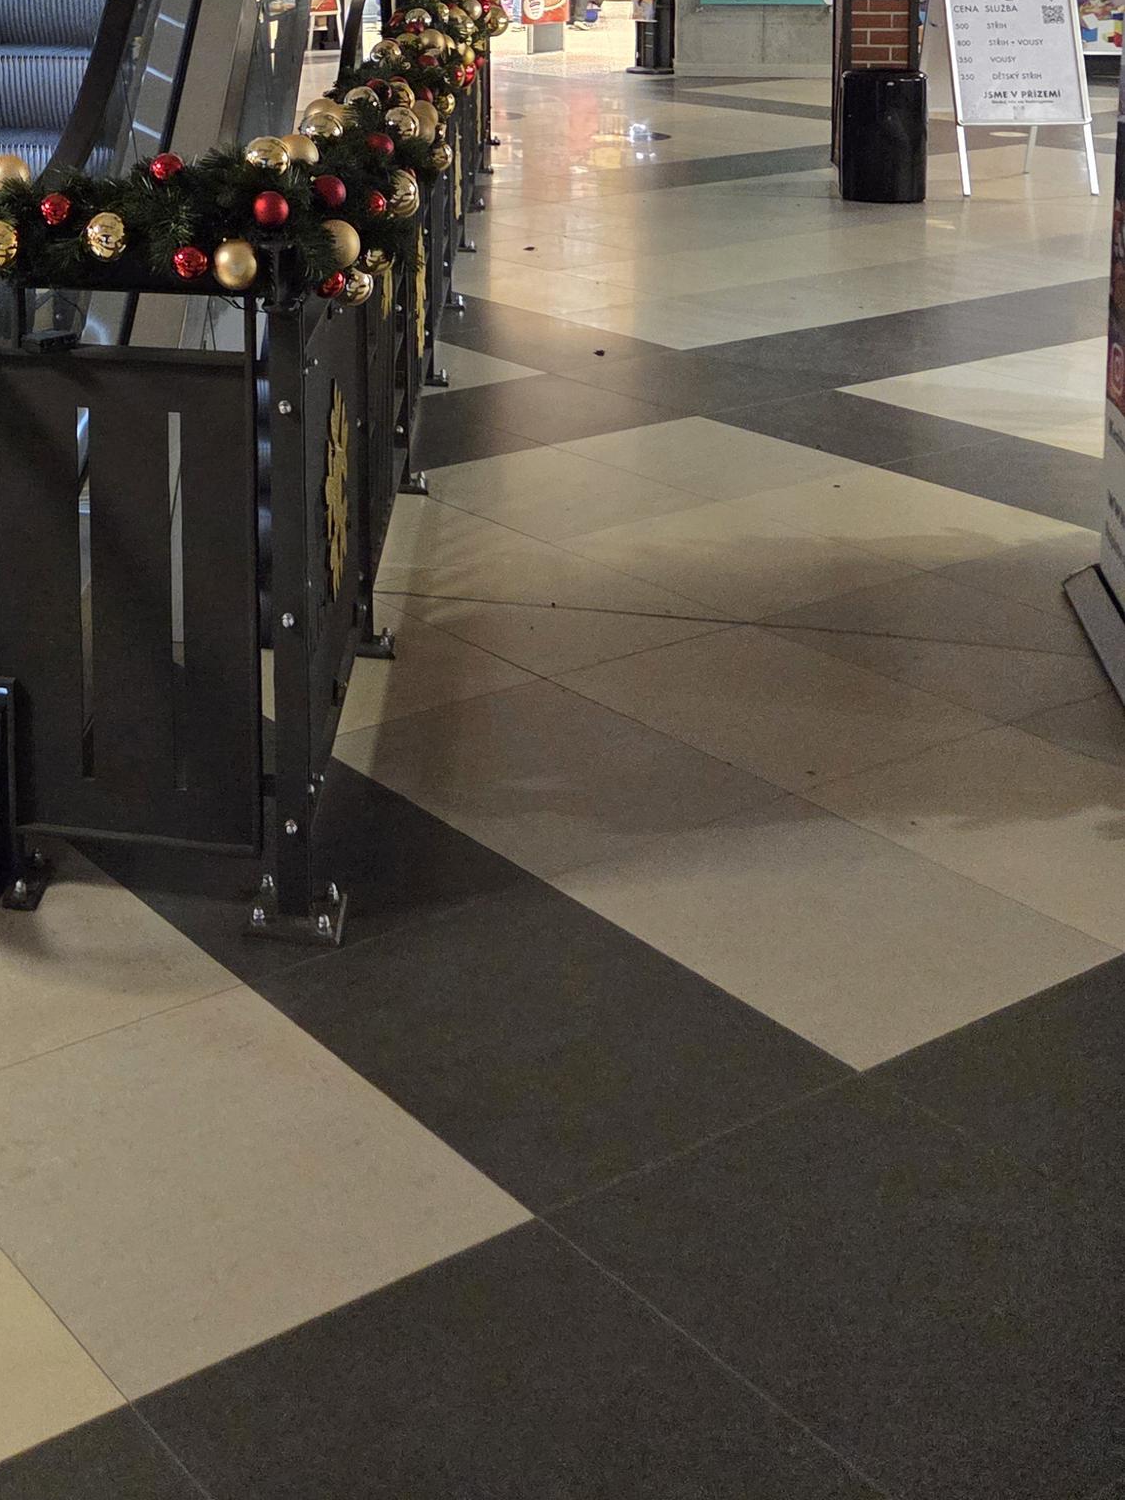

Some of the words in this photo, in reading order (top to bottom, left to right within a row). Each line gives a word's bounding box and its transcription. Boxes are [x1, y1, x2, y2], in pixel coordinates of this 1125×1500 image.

[953, 5, 979, 13] CENA
[985, 3, 1018, 13] SLUŽBA
[983, 90, 1007, 99] JSME
[1010, 90, 1018, 98] V
[1021, 88, 1061, 98] PŘÍZEMÍ
